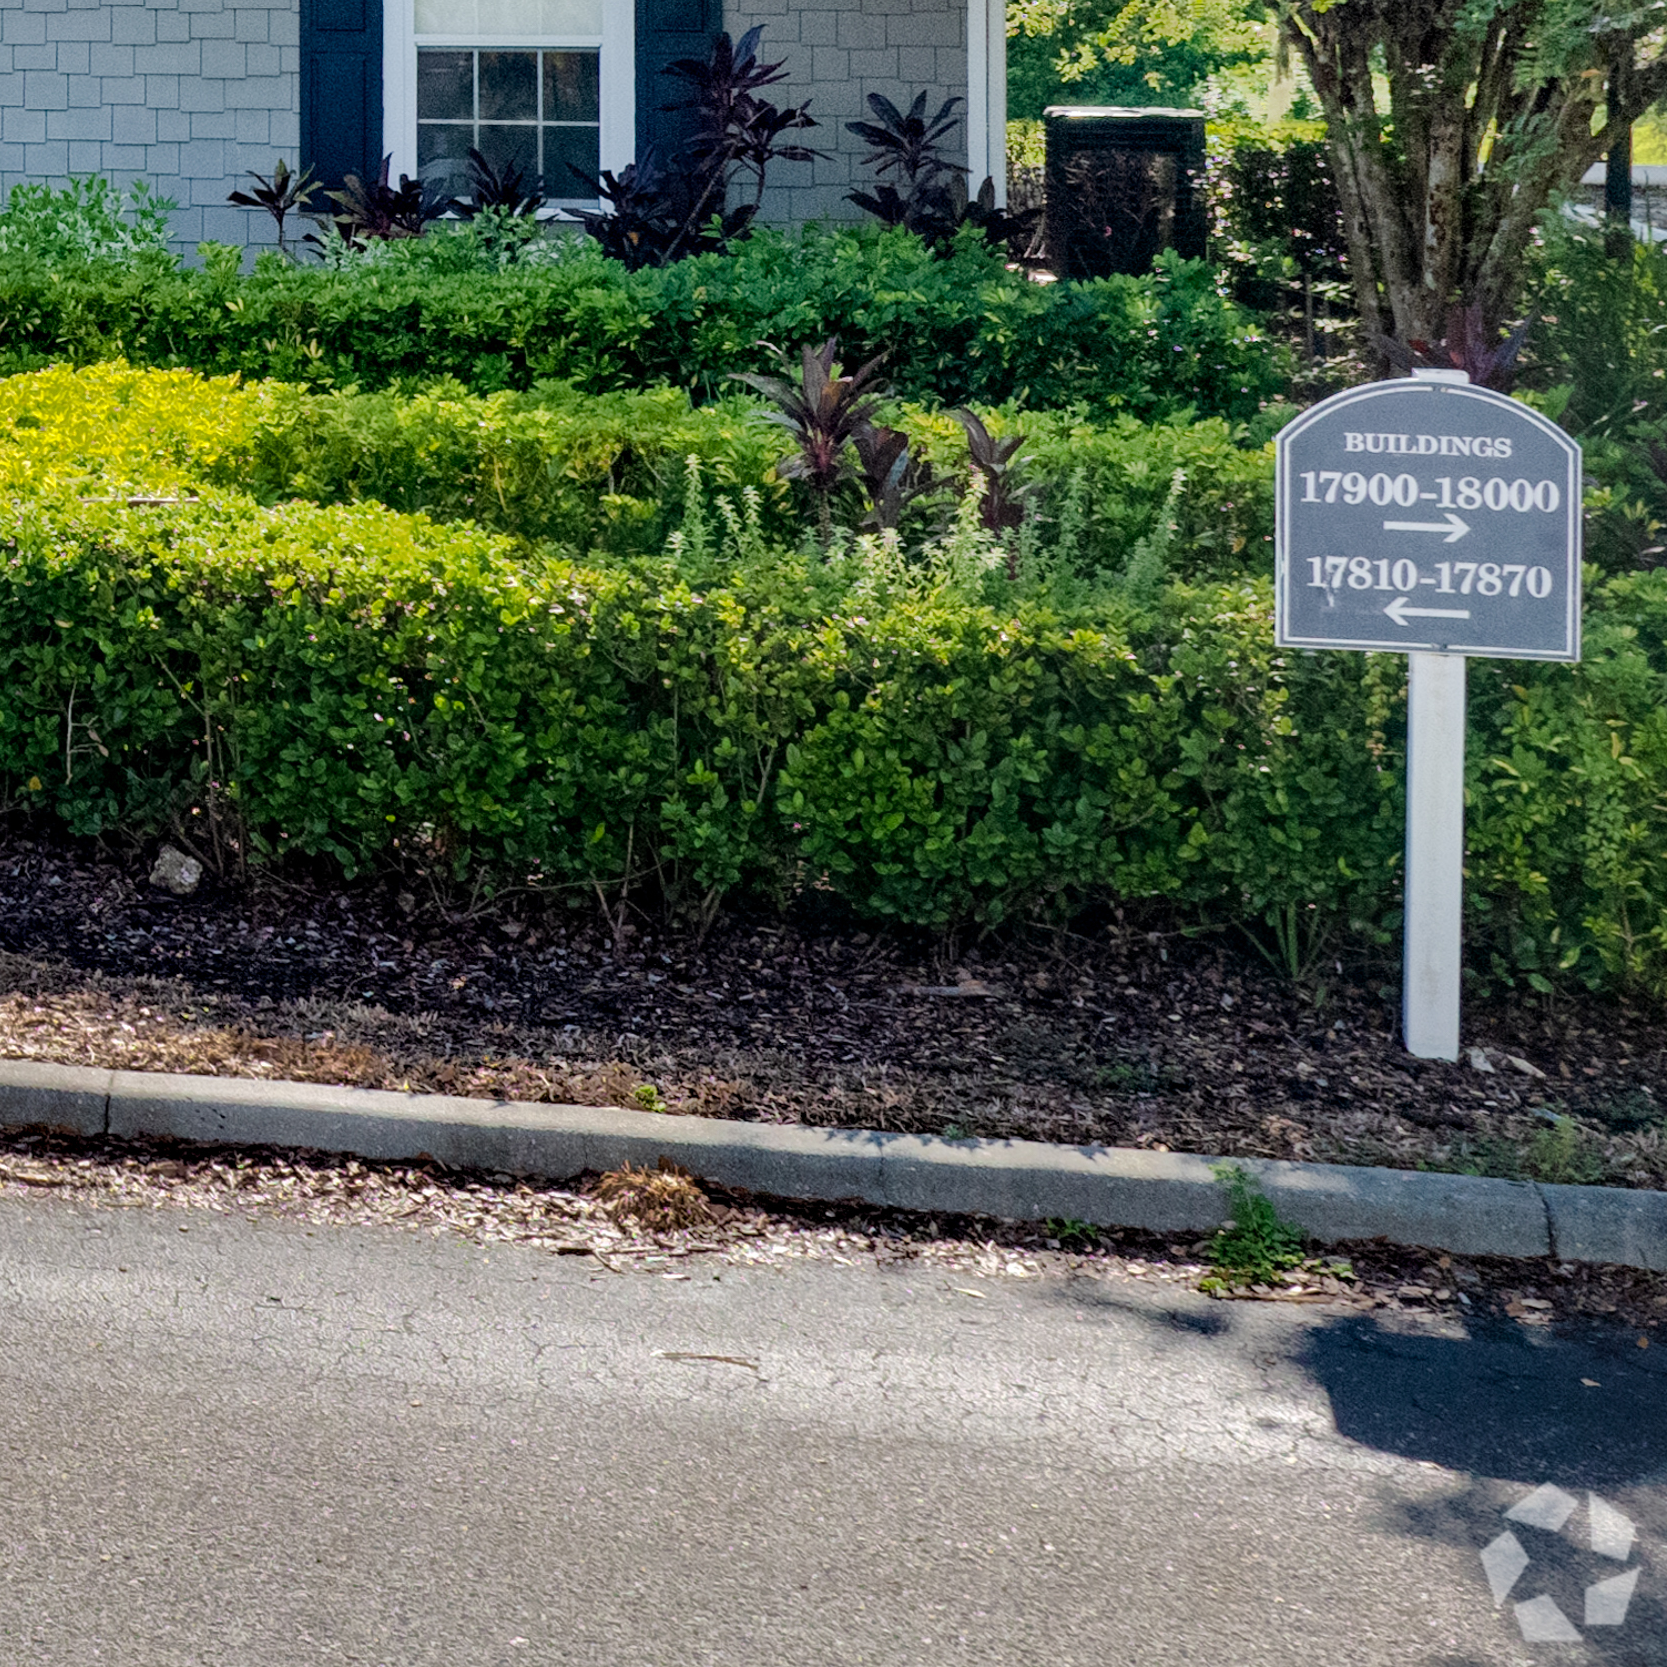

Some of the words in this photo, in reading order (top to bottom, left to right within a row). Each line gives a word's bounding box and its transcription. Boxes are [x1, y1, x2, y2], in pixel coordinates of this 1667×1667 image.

[1343, 432, 1512, 458] BUILDINGS
[1299, 471, 1560, 513] 17900-18000
[1306, 556, 1552, 598] 17810-17870
